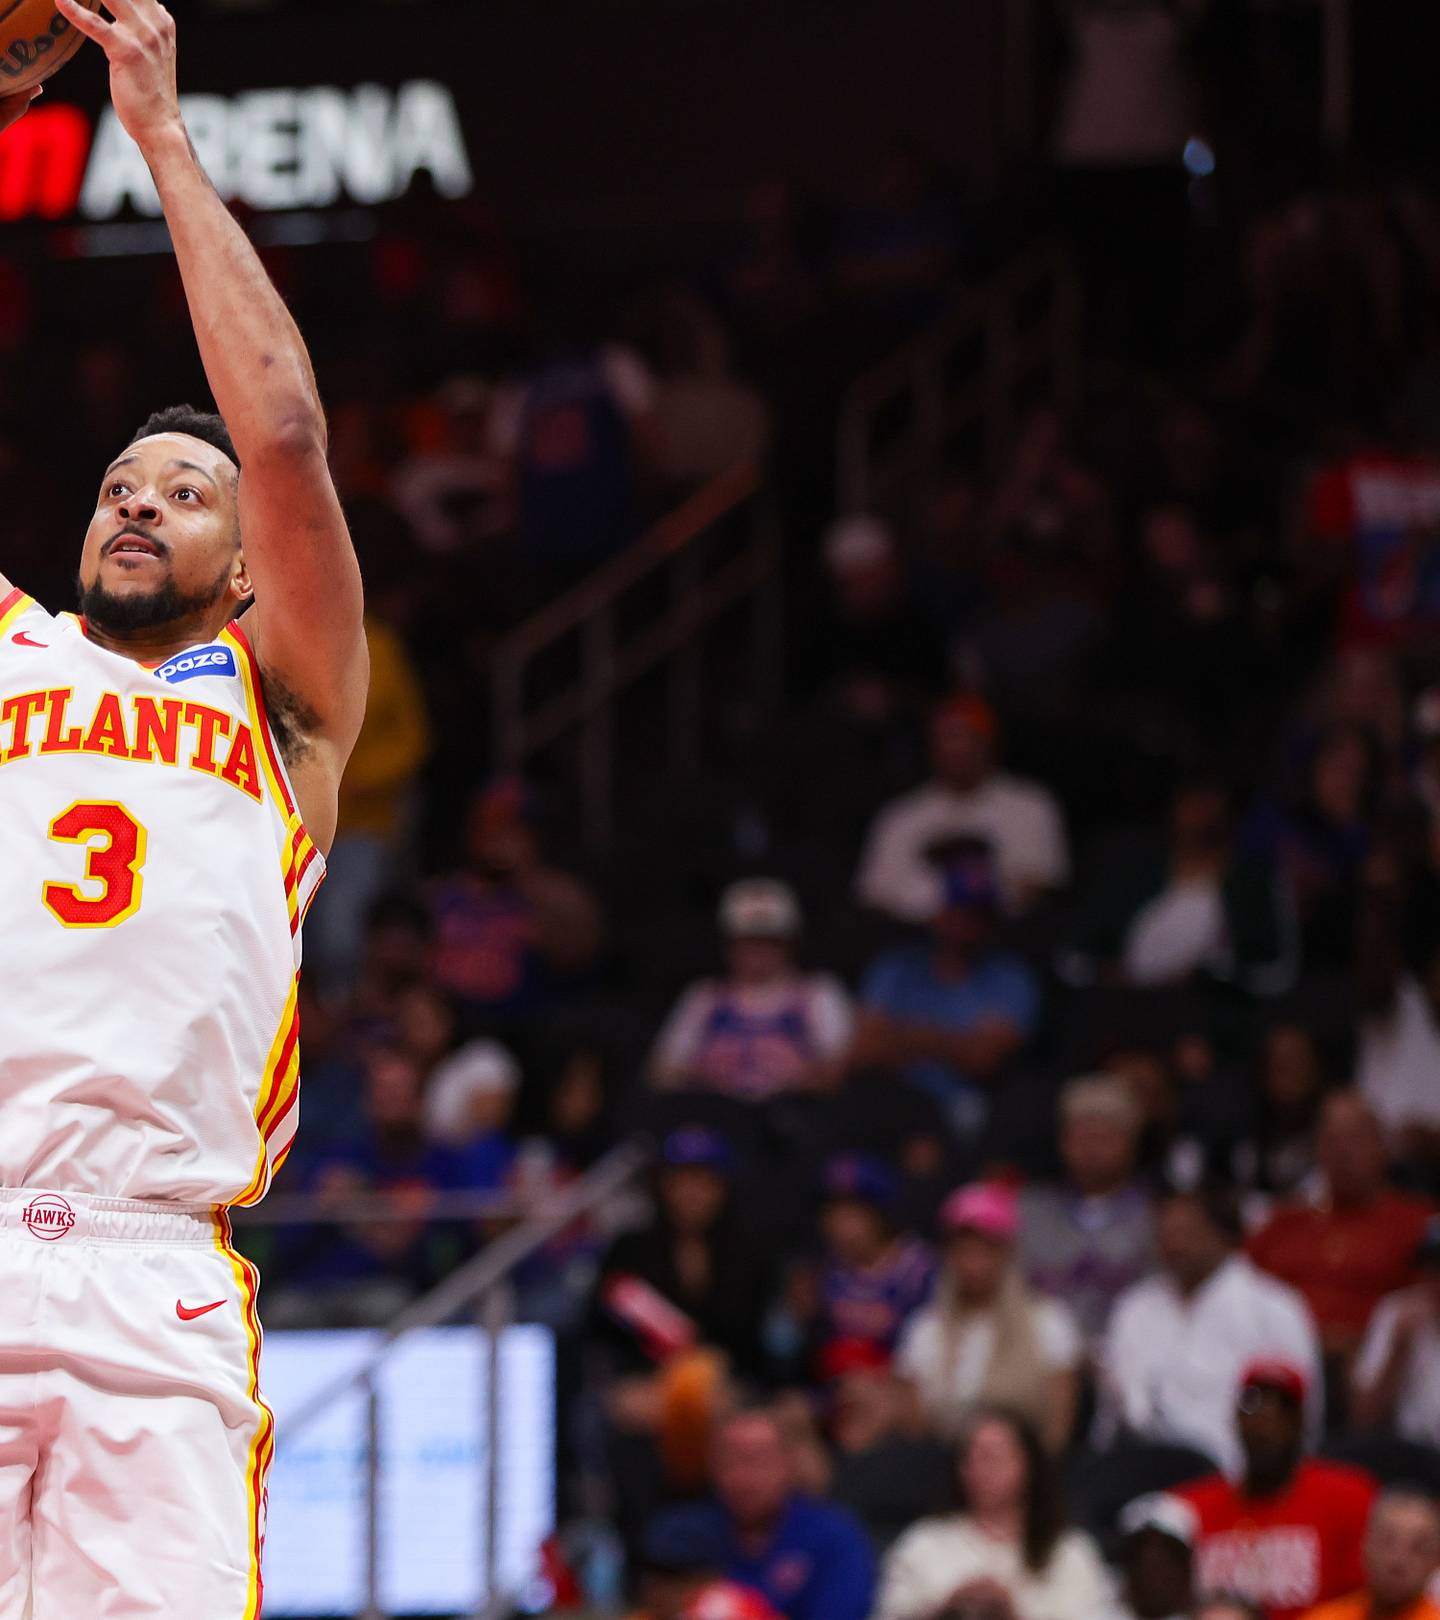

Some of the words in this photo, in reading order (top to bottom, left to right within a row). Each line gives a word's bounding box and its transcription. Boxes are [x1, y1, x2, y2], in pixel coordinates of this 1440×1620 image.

[159, 652, 228, 682] paze
[42, 800, 148, 928] 3
[22, 1208, 76, 1227] HAWKS
